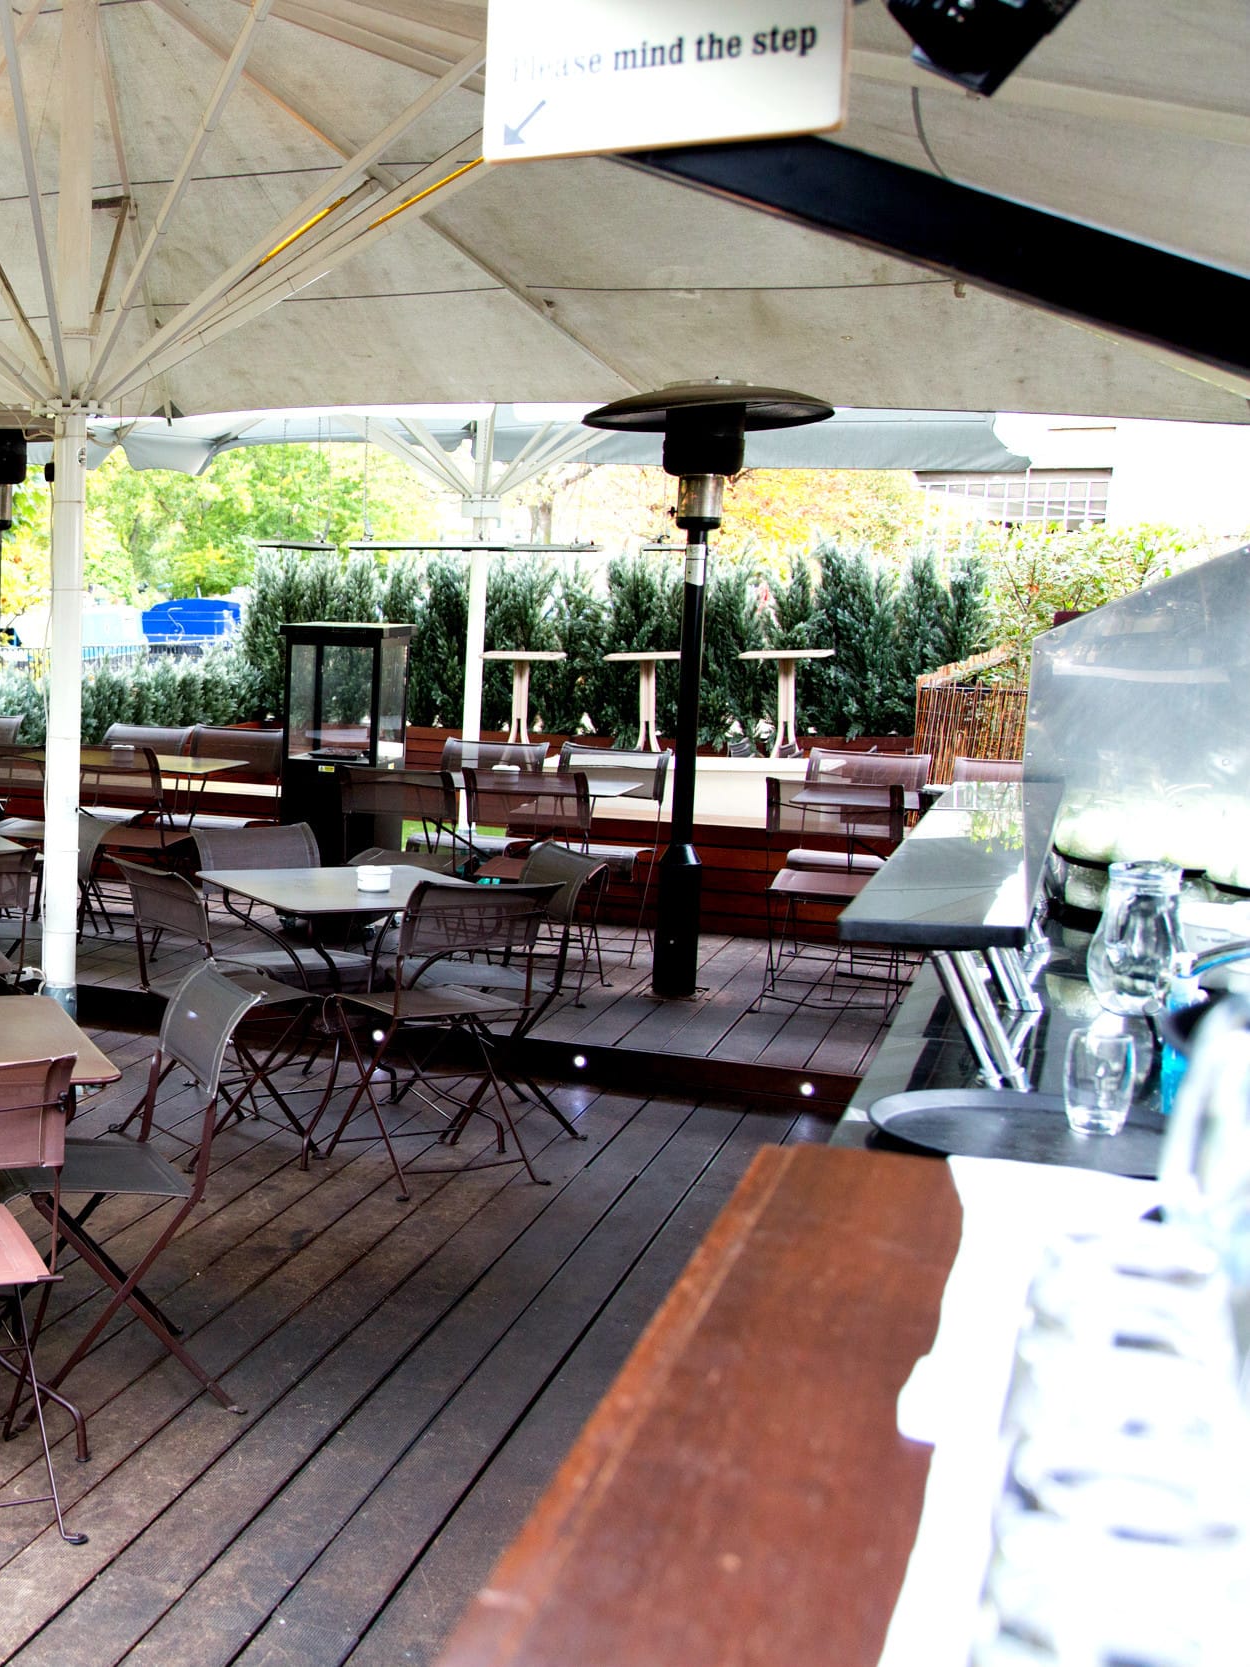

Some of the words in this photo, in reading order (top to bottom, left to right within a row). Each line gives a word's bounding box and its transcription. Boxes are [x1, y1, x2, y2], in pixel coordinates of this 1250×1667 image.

[613, 37, 684, 72] mind
[696, 32, 742, 62] the
[752, 25, 817, 57] step
